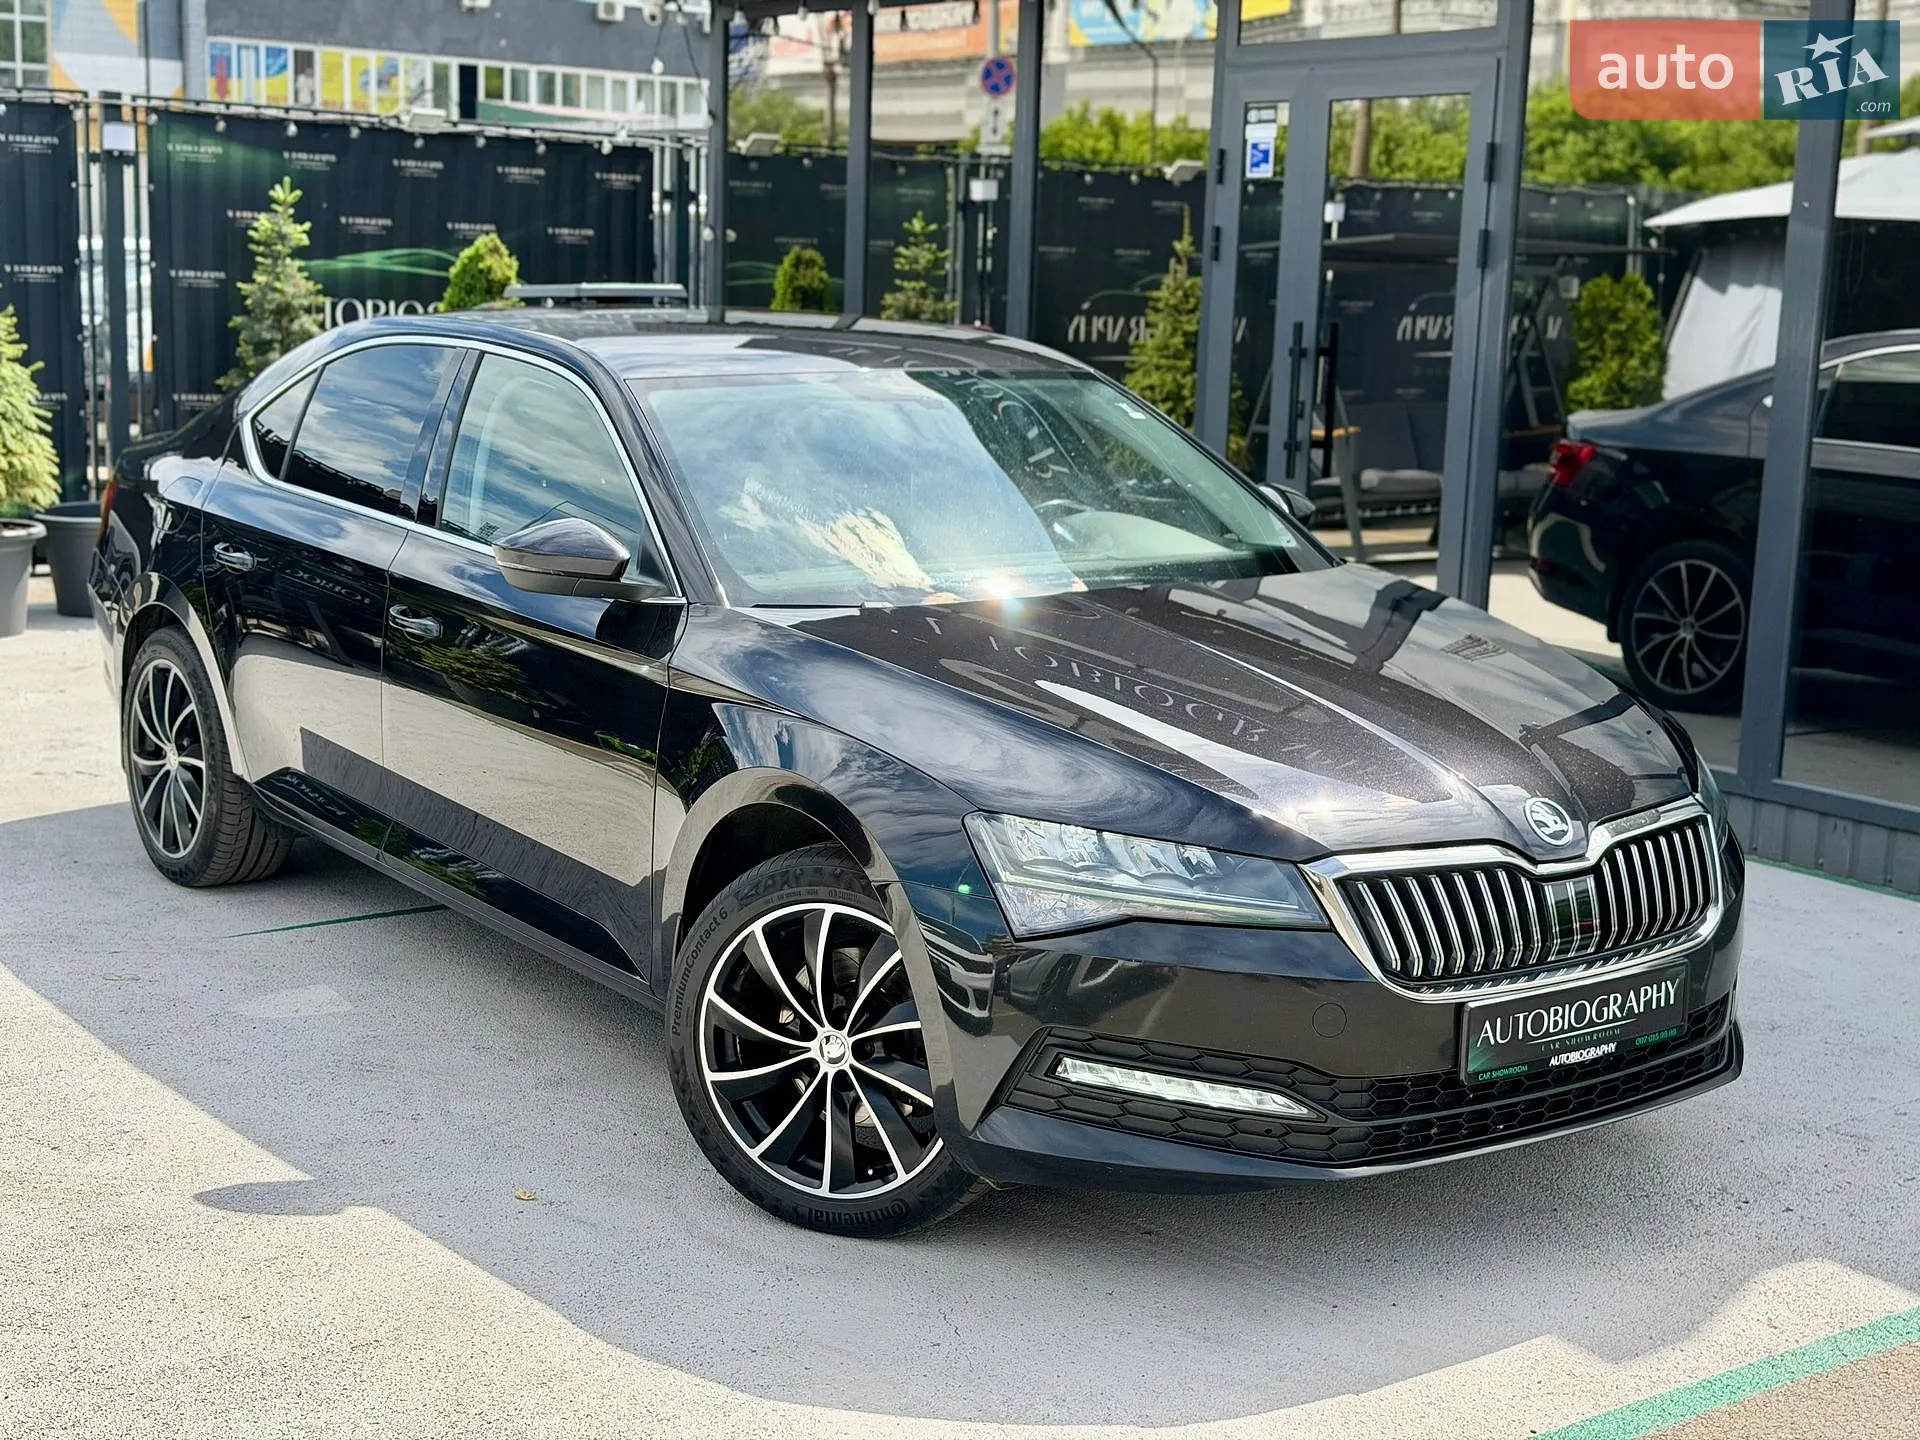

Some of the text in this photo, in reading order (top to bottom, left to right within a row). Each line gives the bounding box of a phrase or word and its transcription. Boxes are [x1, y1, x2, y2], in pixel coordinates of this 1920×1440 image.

[672, 906, 729, 1036] PremiumContact 6
[1476, 978, 1680, 1048] AUTOBIOGRAPHY
[1478, 1064, 1528, 1081] CAR SHOWROOM
[1548, 1041, 1618, 1068] AUTOBIOGRAPHY
